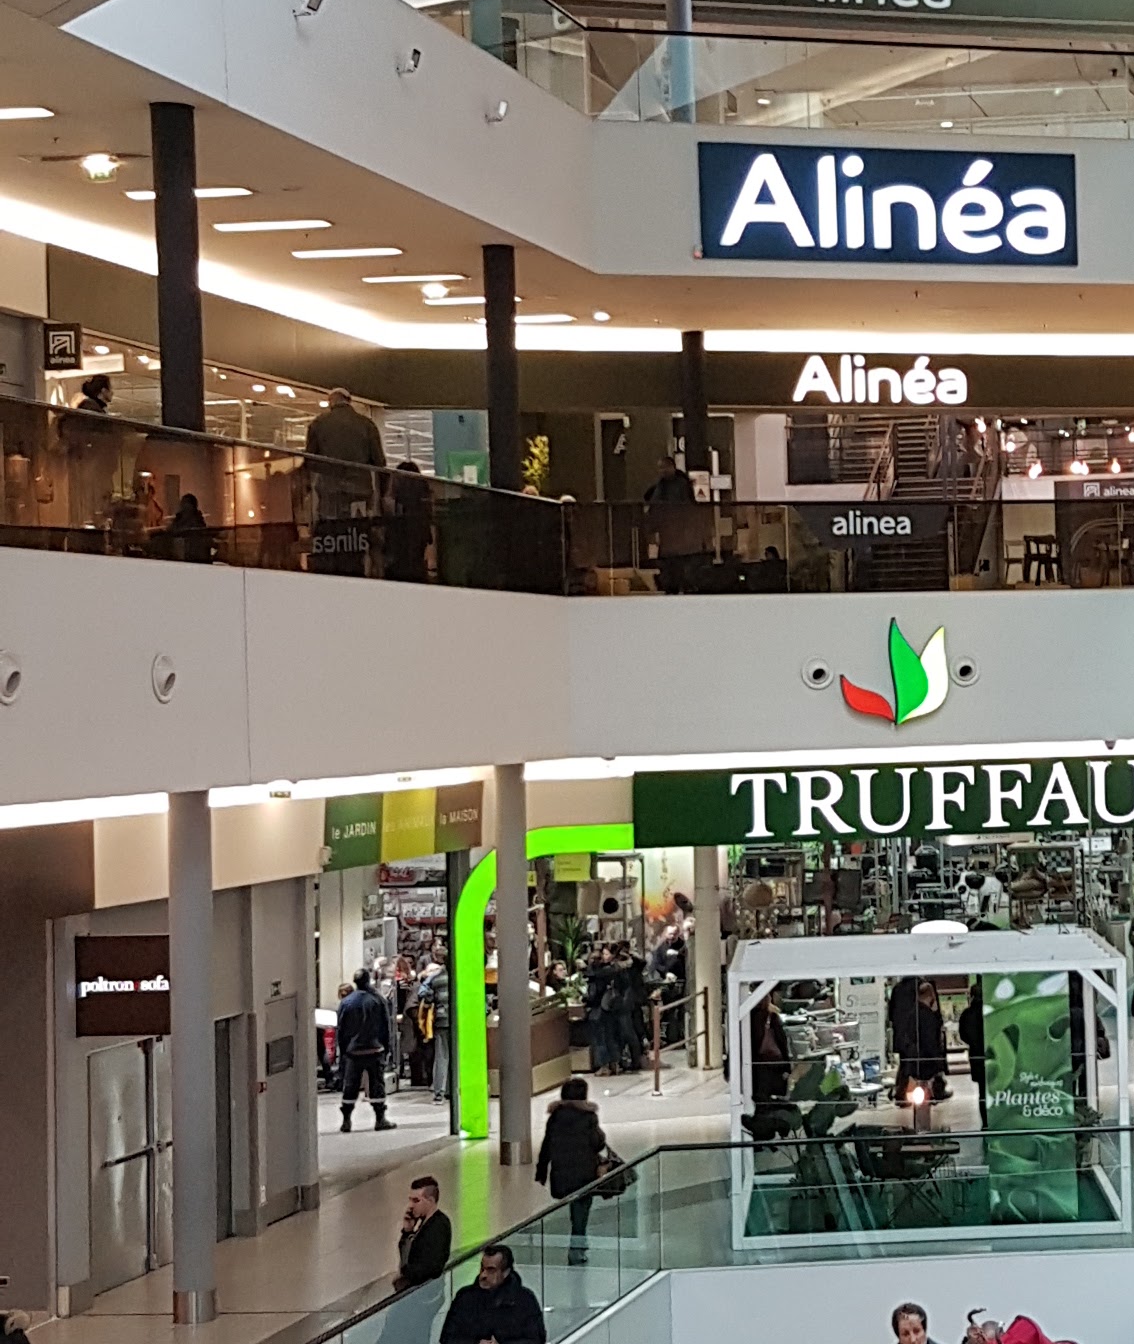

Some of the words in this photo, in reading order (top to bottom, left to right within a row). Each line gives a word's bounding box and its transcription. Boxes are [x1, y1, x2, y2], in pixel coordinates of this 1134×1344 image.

[719, 153, 1067, 256] Alinéa
[792, 355, 968, 406] Alinéa
[832, 510, 912, 536] alinea
[449, 808, 479, 824] MAISON
[332, 826, 341, 839] le
[343, 821, 377, 839] JARDIN
[994, 1089, 1060, 1107] Plantes
[1033, 1105, 1064, 1117] déco
